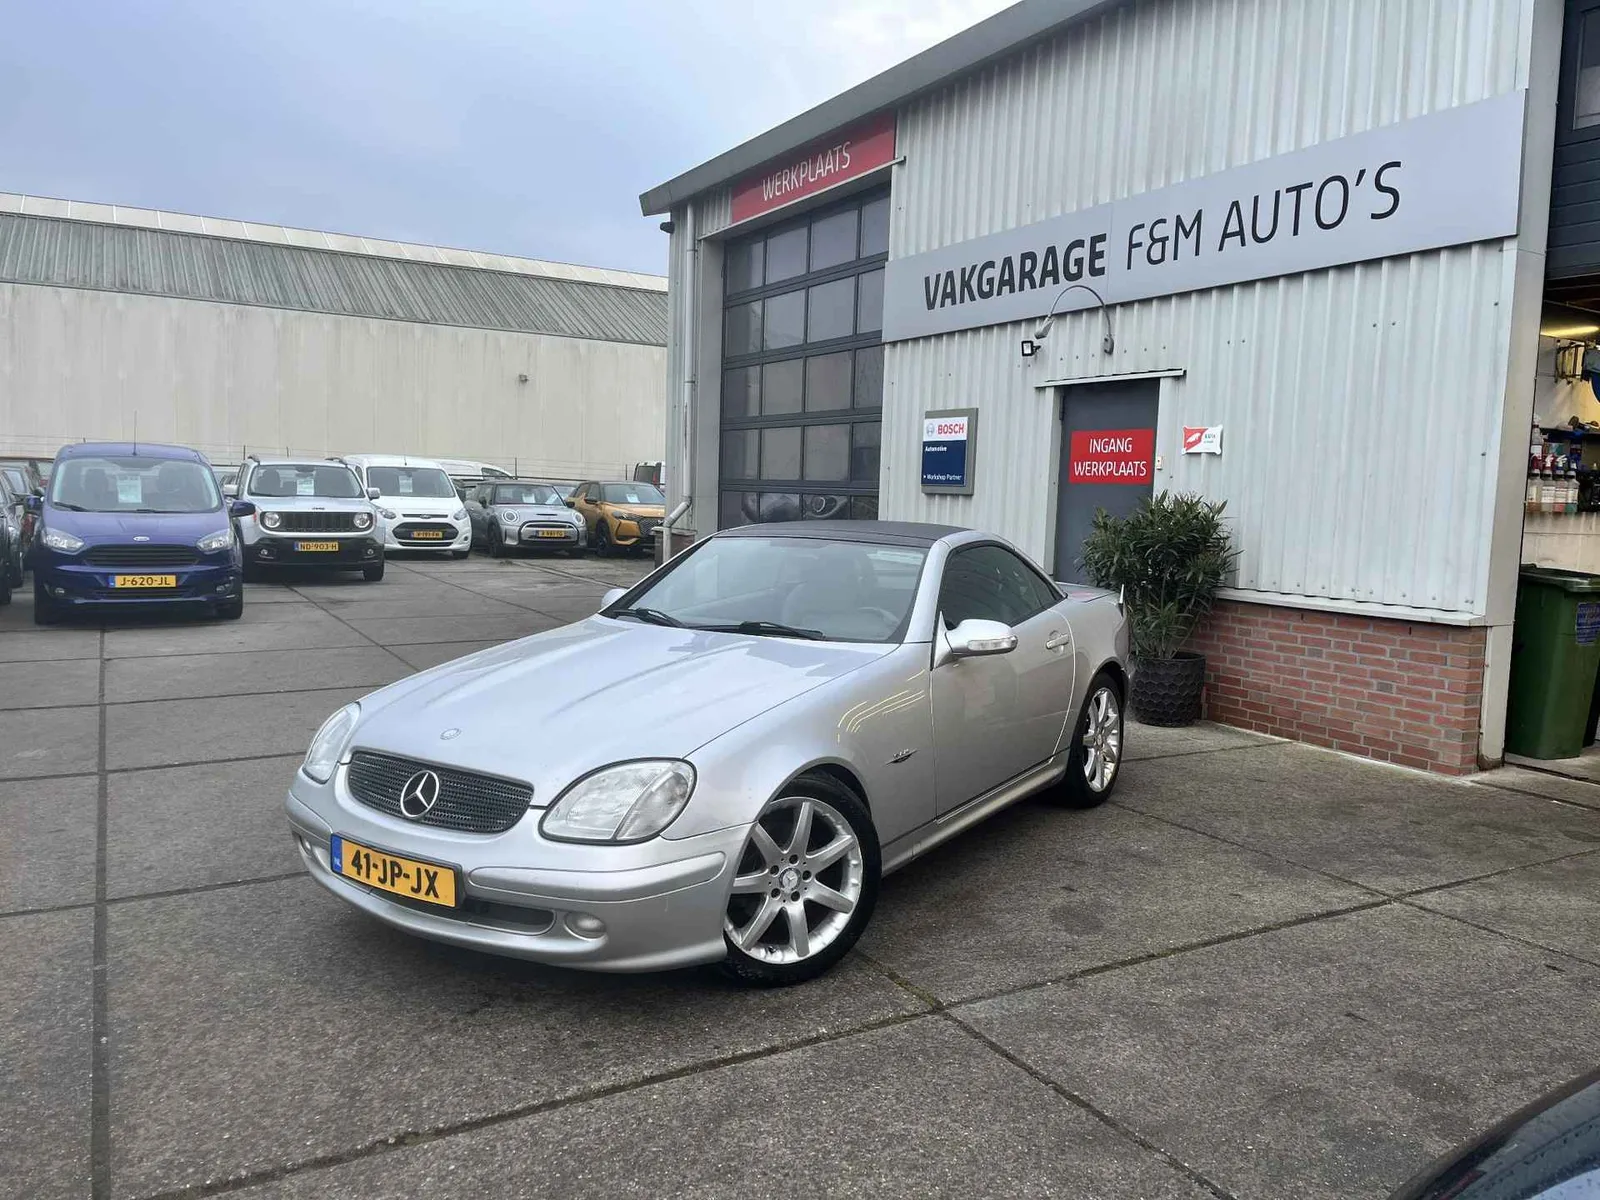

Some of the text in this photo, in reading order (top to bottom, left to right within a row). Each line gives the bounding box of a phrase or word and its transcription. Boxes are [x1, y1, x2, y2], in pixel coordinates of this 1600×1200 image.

[762, 141, 851, 201] WERKPLAATS
[924, 161, 1402, 311] VAKGARAGE F&M AUTO'S
[937, 423, 965, 435] BOSCH
[1089, 437, 1133, 454] INGANG
[946, 473, 962, 481] Partner
[1074, 461, 1147, 477] WERKPLAATS
[120, 576, 171, 586] J-620-JL
[351, 849, 440, 898] 41-JP-JX
